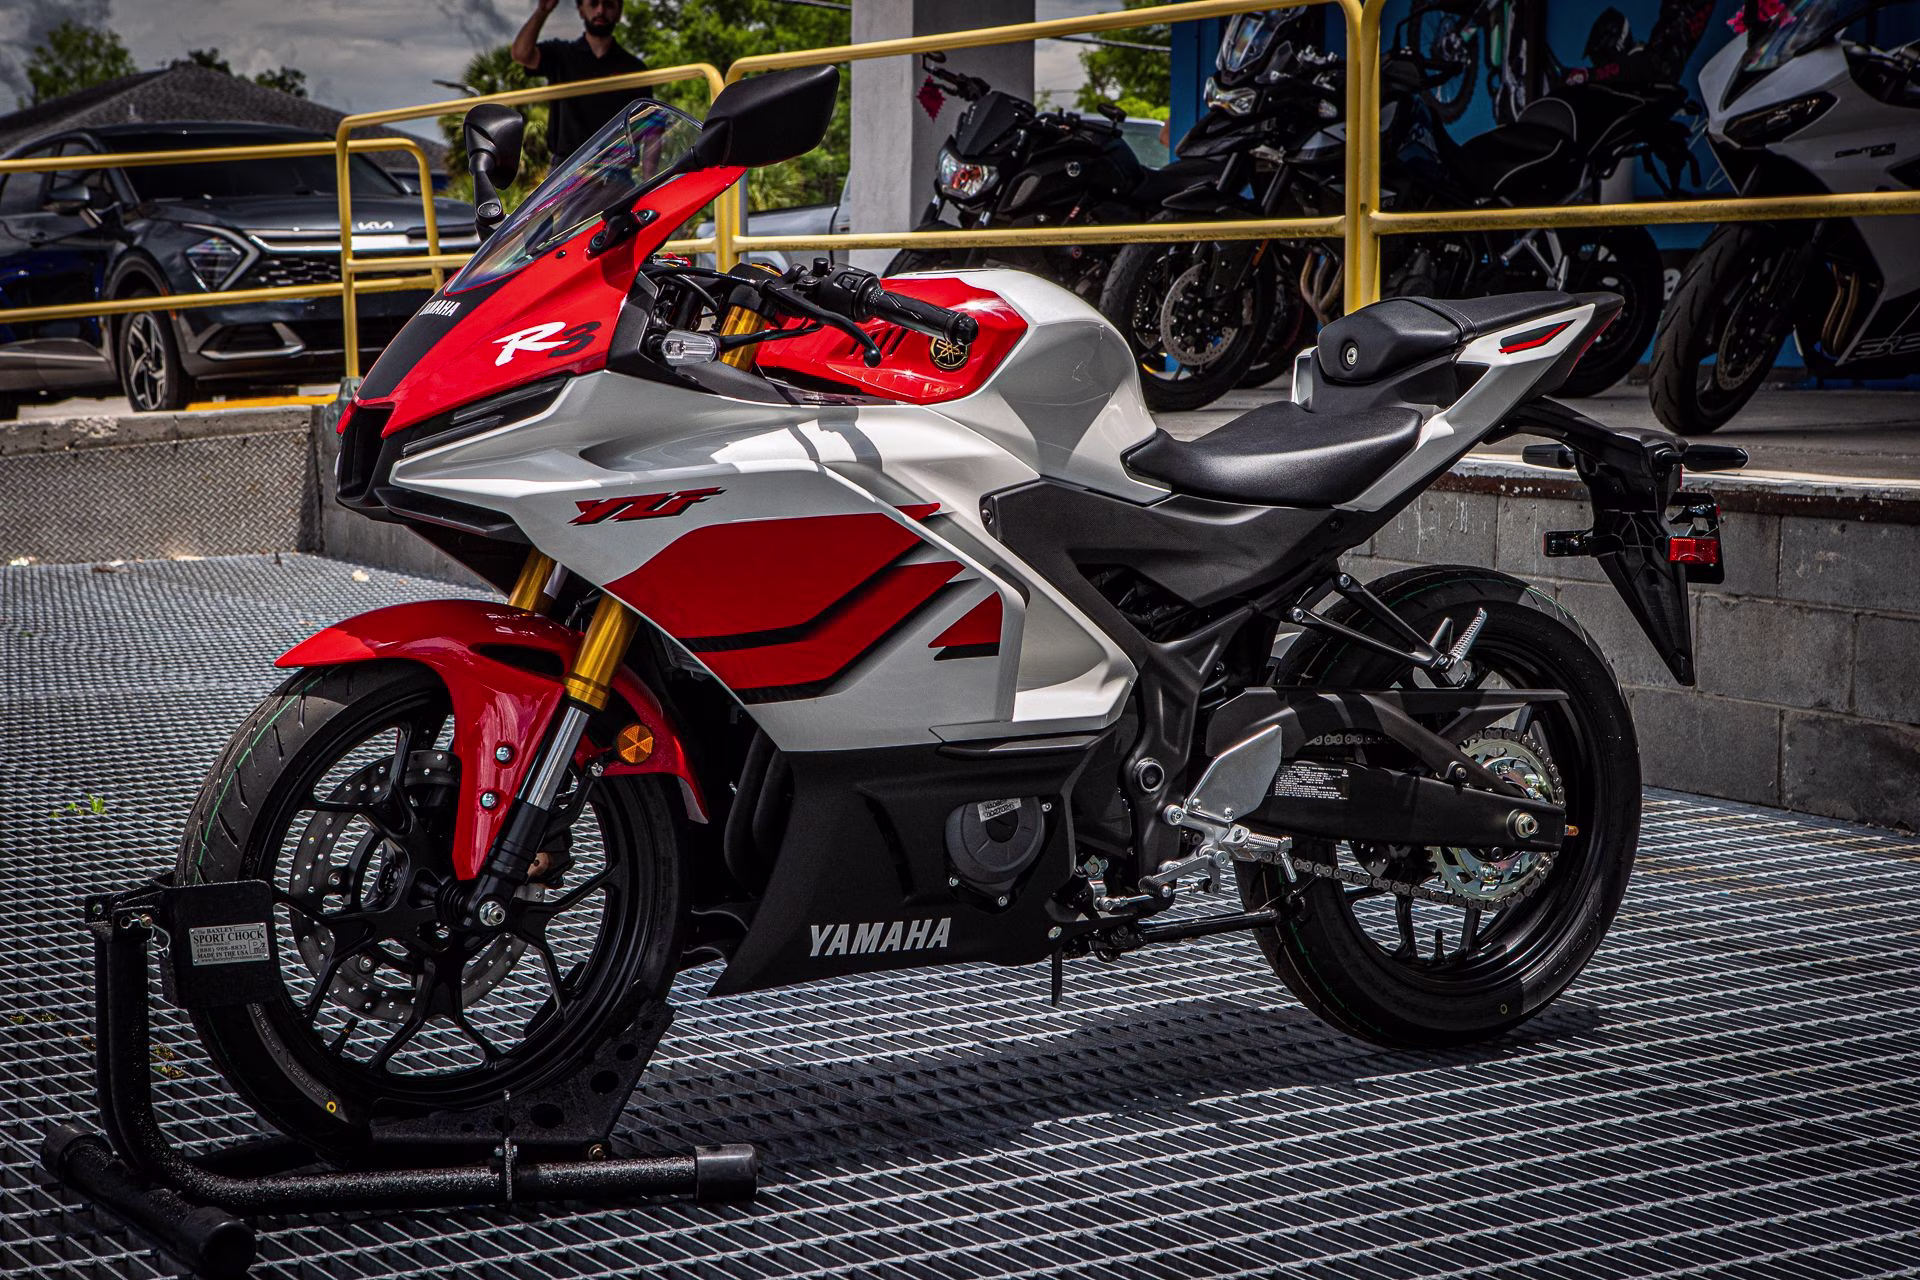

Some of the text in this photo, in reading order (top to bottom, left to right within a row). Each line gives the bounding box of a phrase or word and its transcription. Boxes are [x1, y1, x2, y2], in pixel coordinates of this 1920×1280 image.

[358, 221, 394, 231] KIA
[419, 300, 461, 316] YAMAHA
[492, 321, 602, 367] R3
[193, 933, 226, 945] SPORT
[227, 930, 265, 941] CHOCK
[809, 917, 951, 957] YAMAHA
